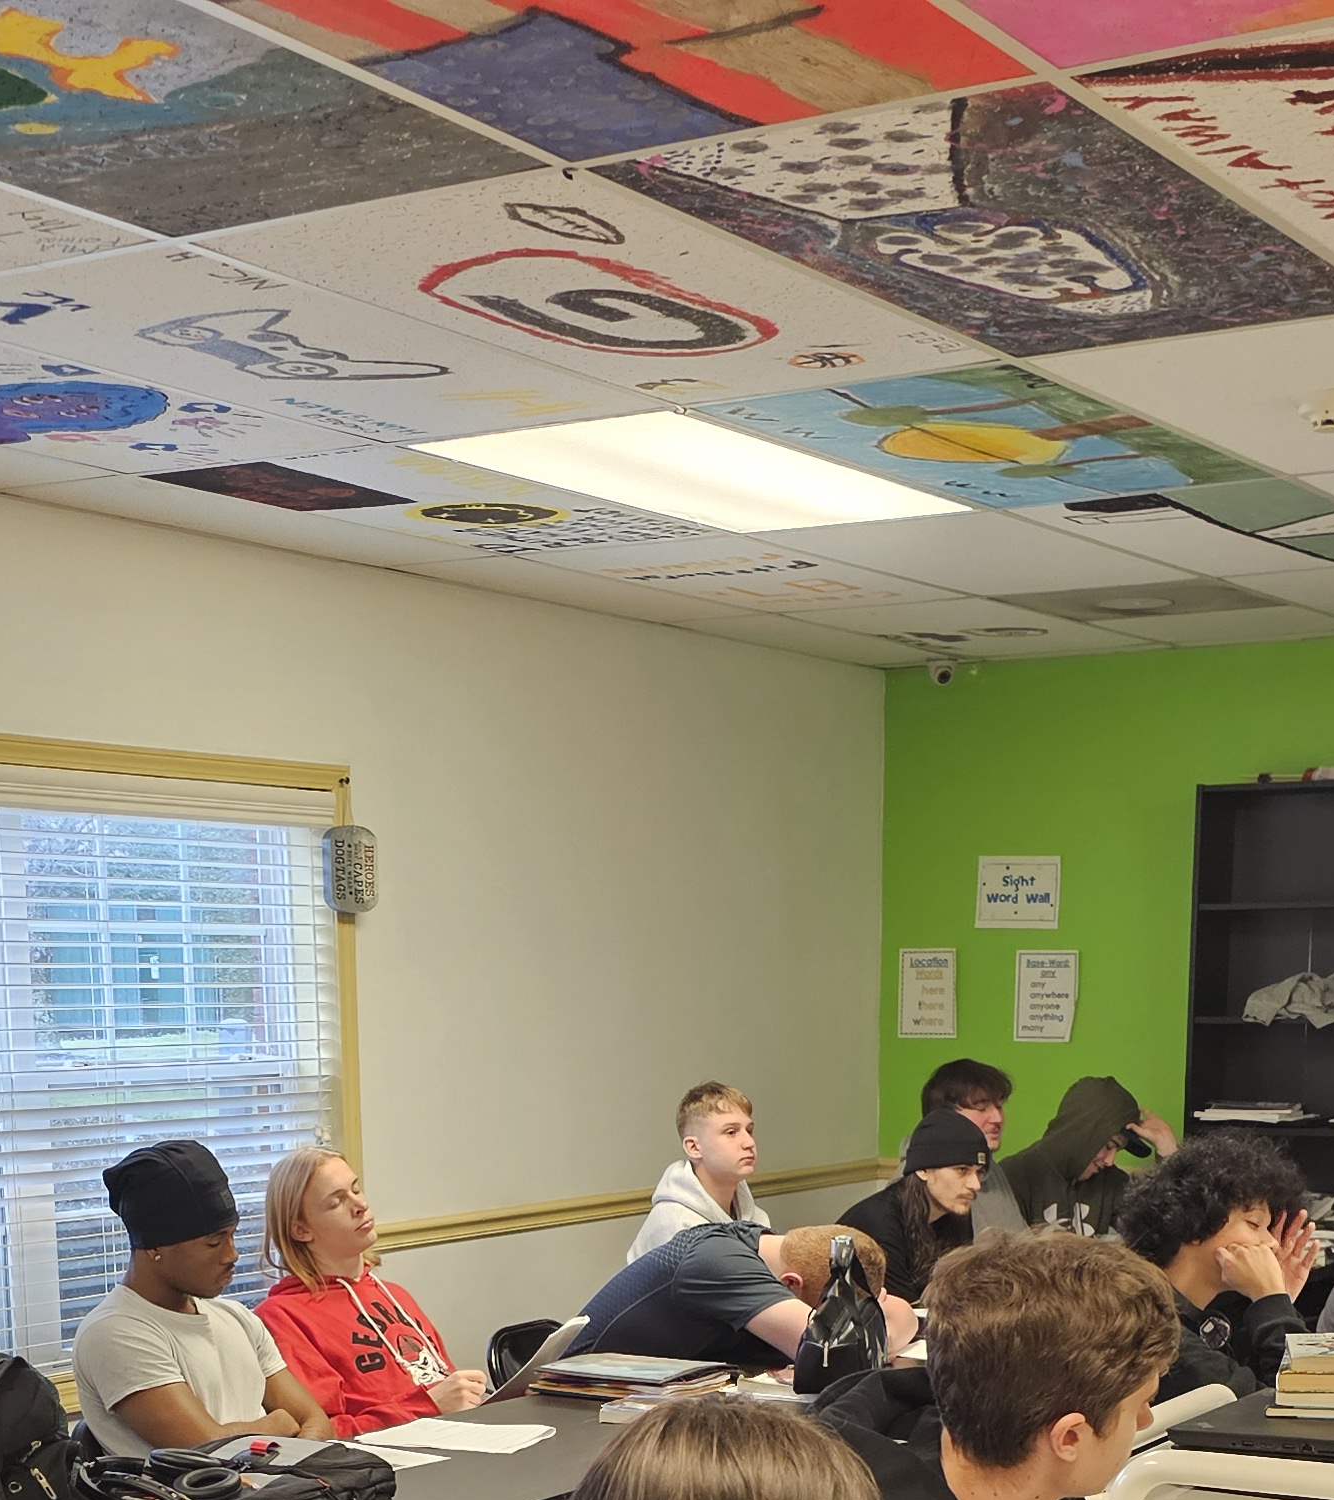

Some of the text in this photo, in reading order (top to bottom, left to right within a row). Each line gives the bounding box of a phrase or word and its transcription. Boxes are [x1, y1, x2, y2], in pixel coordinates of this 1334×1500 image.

[467, 288, 749, 350] G
[1002, 875, 1036, 892] Sight
[986, 892, 1050, 904] Word Wall
[910, 956, 948, 967] Location
[1040, 970, 1056, 978] any
[921, 985, 944, 995] here
[1030, 981, 1046, 989] any
[1030, 991, 1069, 1000] anywhere
[918, 1000, 944, 1011] there
[1029, 1003, 1060, 1011] anyone
[913, 1016, 944, 1027] where
[1029, 1013, 1064, 1022] anything
[1021, 1024, 1044, 1033] many
